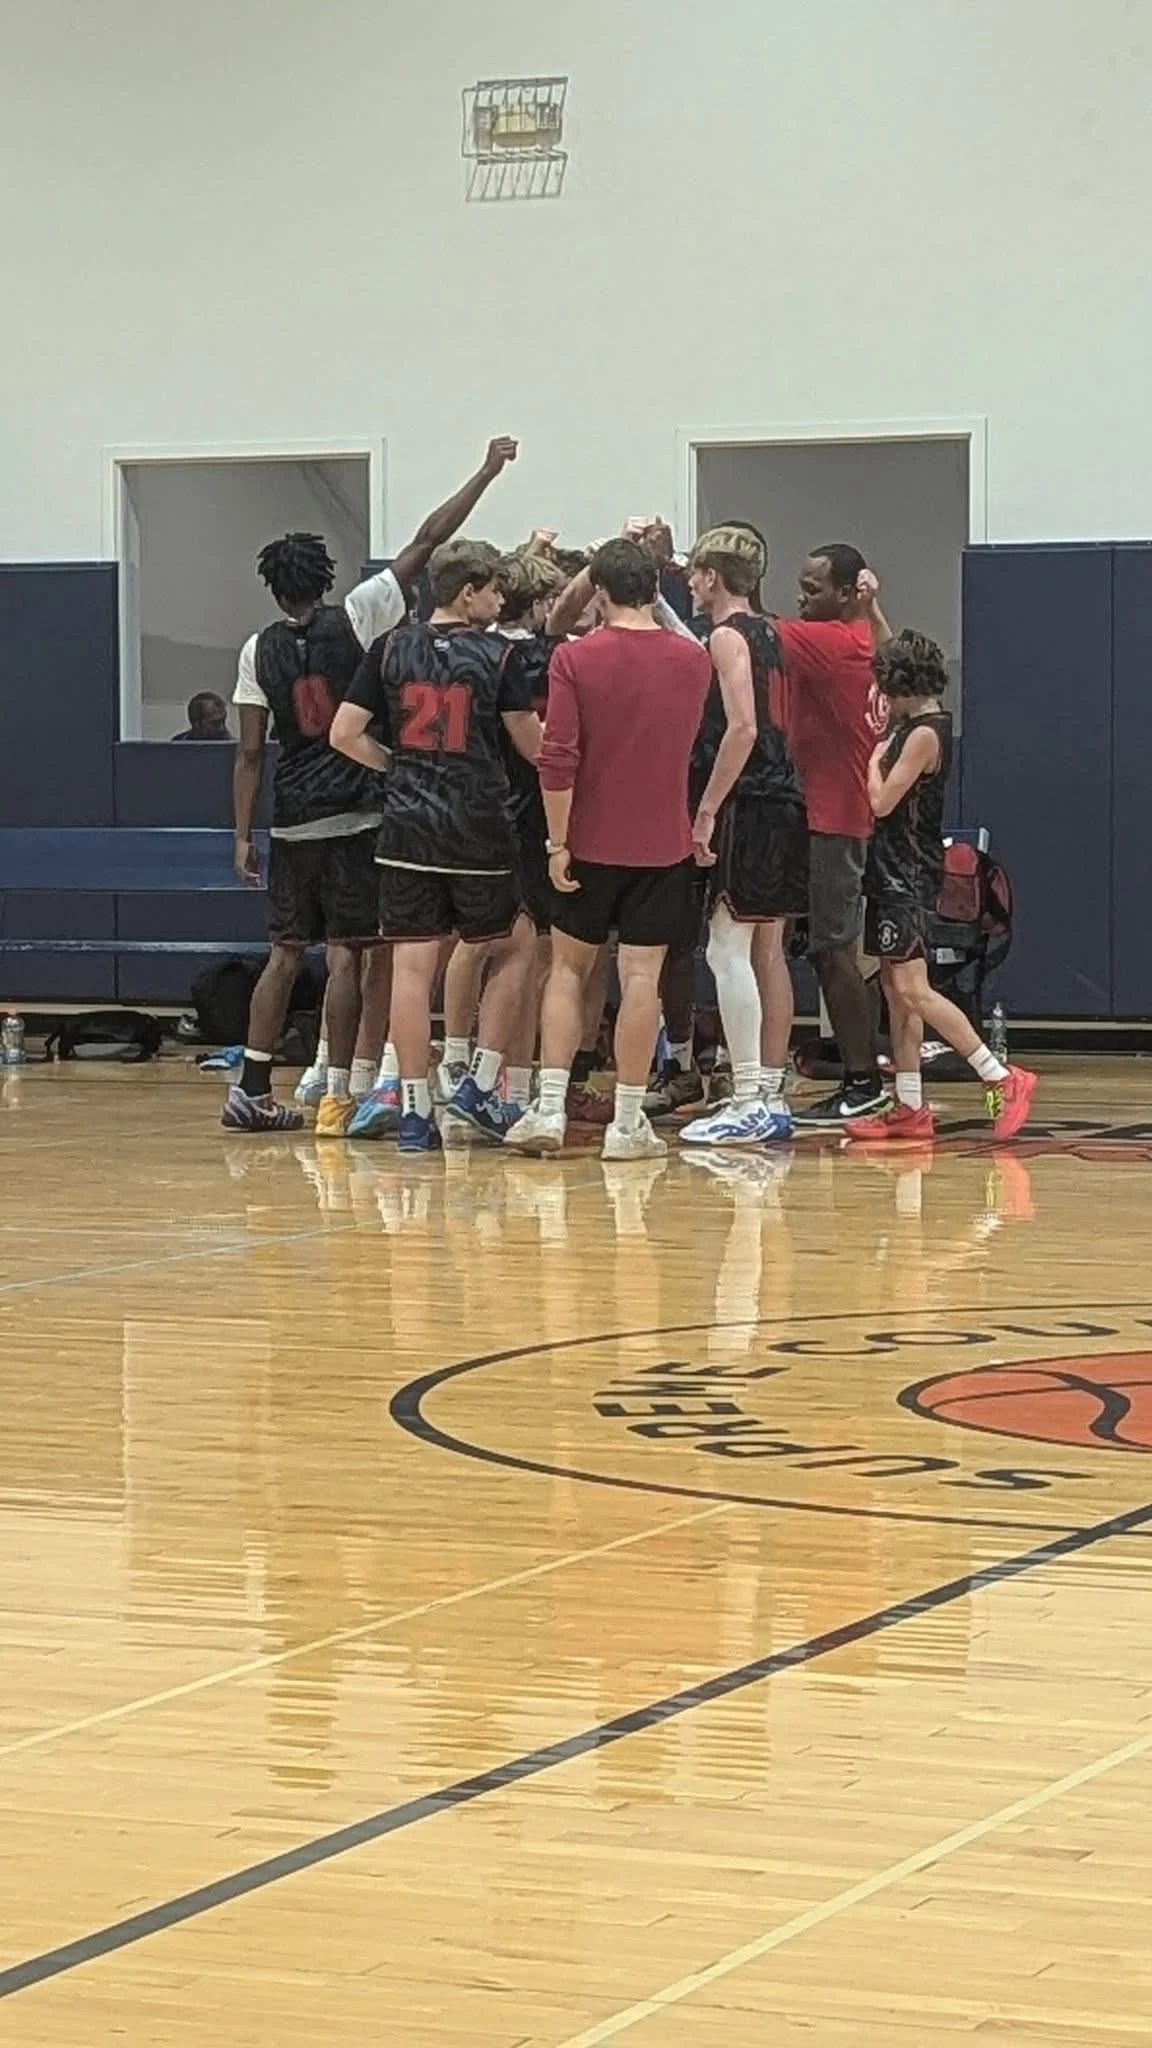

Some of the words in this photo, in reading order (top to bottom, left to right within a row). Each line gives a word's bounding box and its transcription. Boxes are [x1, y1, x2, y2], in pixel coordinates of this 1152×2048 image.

[399, 680, 471, 753] 21
[766, 1319, 1152, 1356] COU
[591, 1361, 1092, 1490] SUPREME
